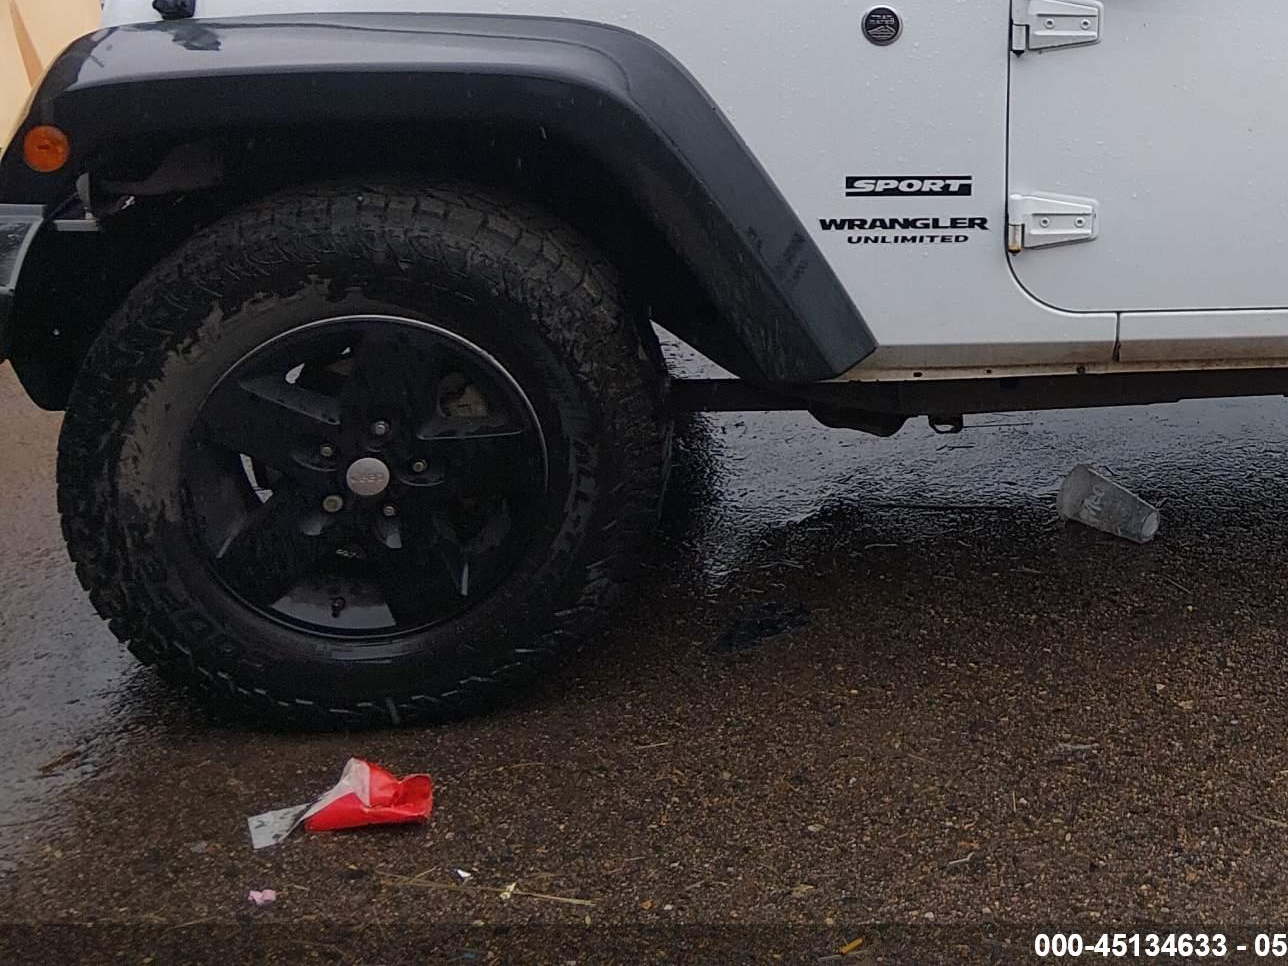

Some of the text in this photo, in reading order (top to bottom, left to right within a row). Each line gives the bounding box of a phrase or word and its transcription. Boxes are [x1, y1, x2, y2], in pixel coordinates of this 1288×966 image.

[846, 178, 972, 194] SPORT
[819, 218, 989, 230] WRANGLER
[848, 235, 969, 244] UNLIMITED
